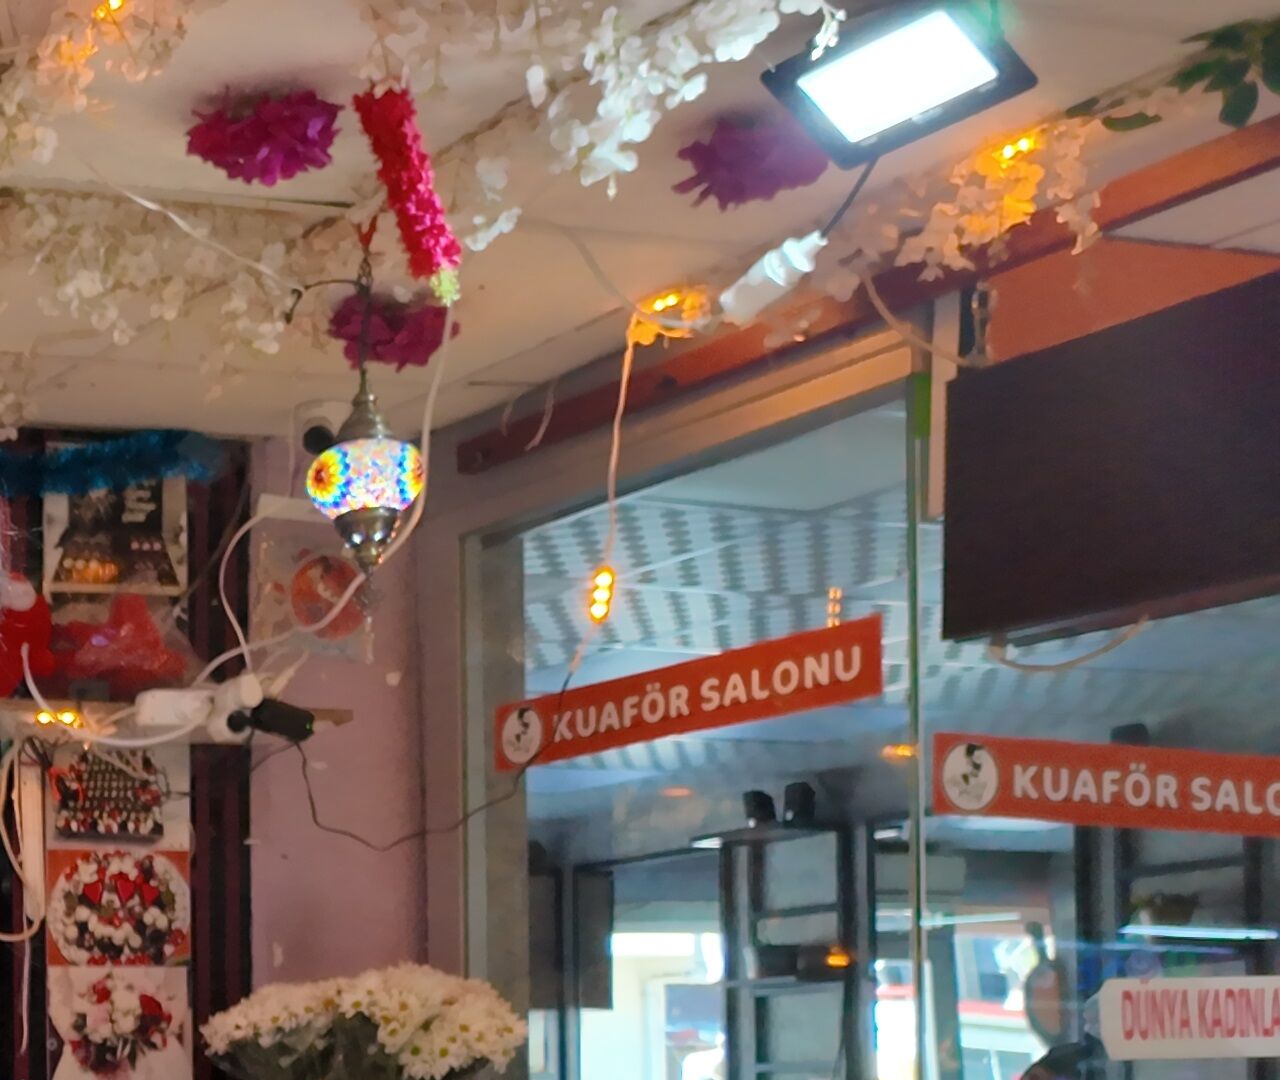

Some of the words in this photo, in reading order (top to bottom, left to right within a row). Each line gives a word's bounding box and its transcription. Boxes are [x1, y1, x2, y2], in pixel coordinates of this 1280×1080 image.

[552, 683, 690, 743] KUAFÖR
[700, 645, 862, 711] SALONU
[1012, 763, 1179, 810] KUAFÖR
[1121, 977, 1193, 1041] DÜNYA
